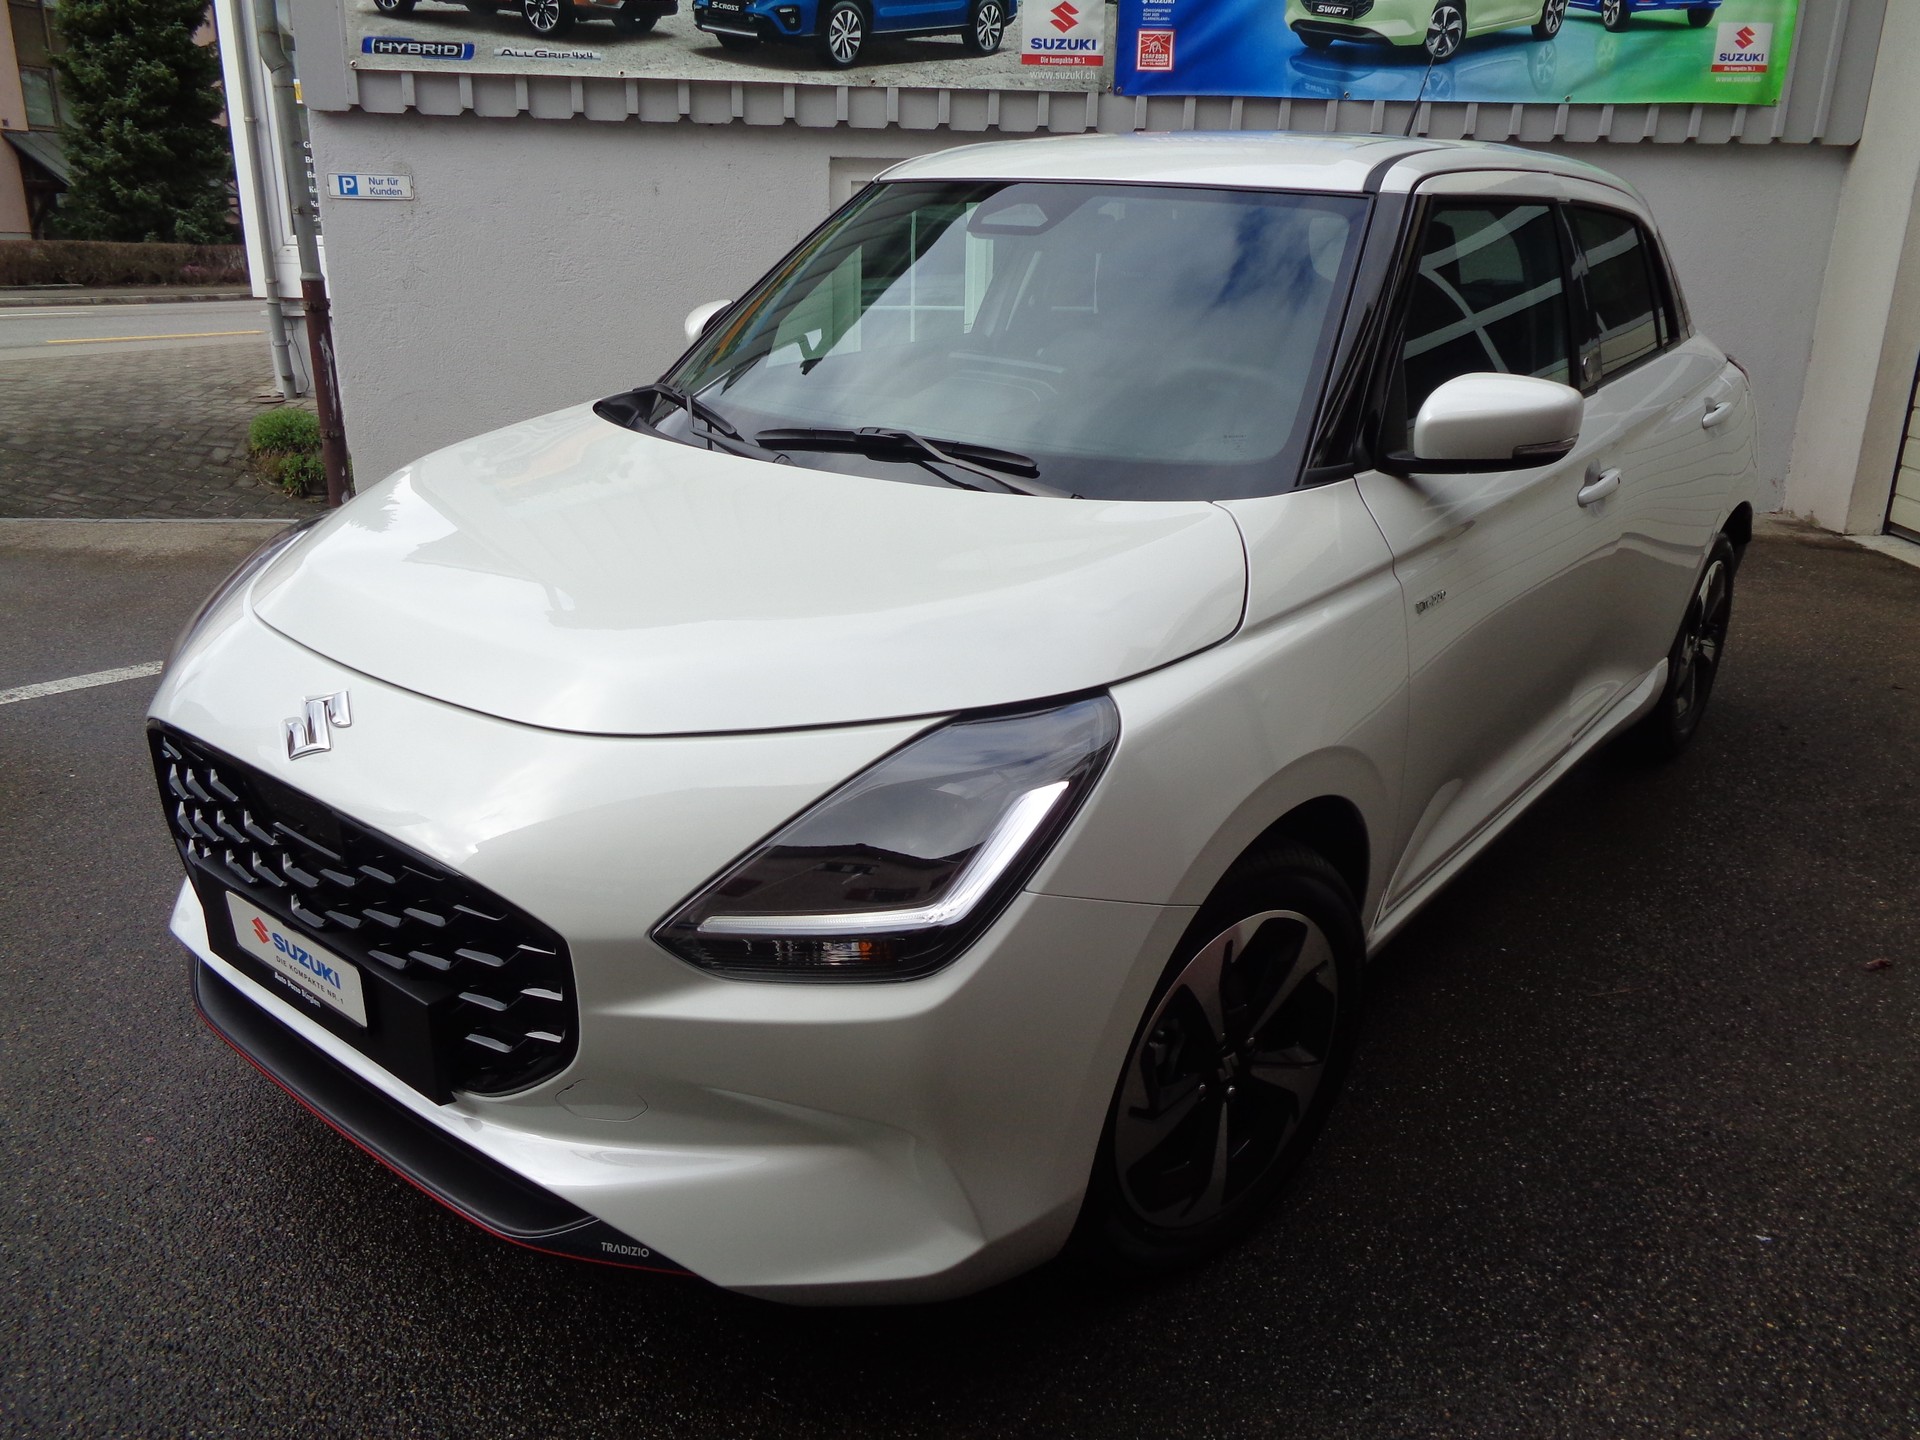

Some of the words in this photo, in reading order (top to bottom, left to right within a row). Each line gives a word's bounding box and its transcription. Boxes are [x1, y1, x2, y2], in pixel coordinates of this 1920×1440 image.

[1317, 5, 1348, 15] SWIFT
[378, 41, 458, 56] HYBRID
[1031, 38, 1096, 50] SUZUKI
[1050, 56, 1073, 65] kompakte
[1719, 53, 1764, 62] SUZUKI
[1029, 70, 1096, 80] www.suzuki.ch
[341, 177, 355, 194] P
[368, 177, 384, 186] Nur
[387, 177, 399, 186] für
[369, 187, 403, 196] Kunden
[272, 932, 342, 990] SUZUKI
[276, 955, 287, 968] DIE
[289, 964, 325, 992] KOMPAKTE
[601, 1242, 649, 1258] TRADIZIO
